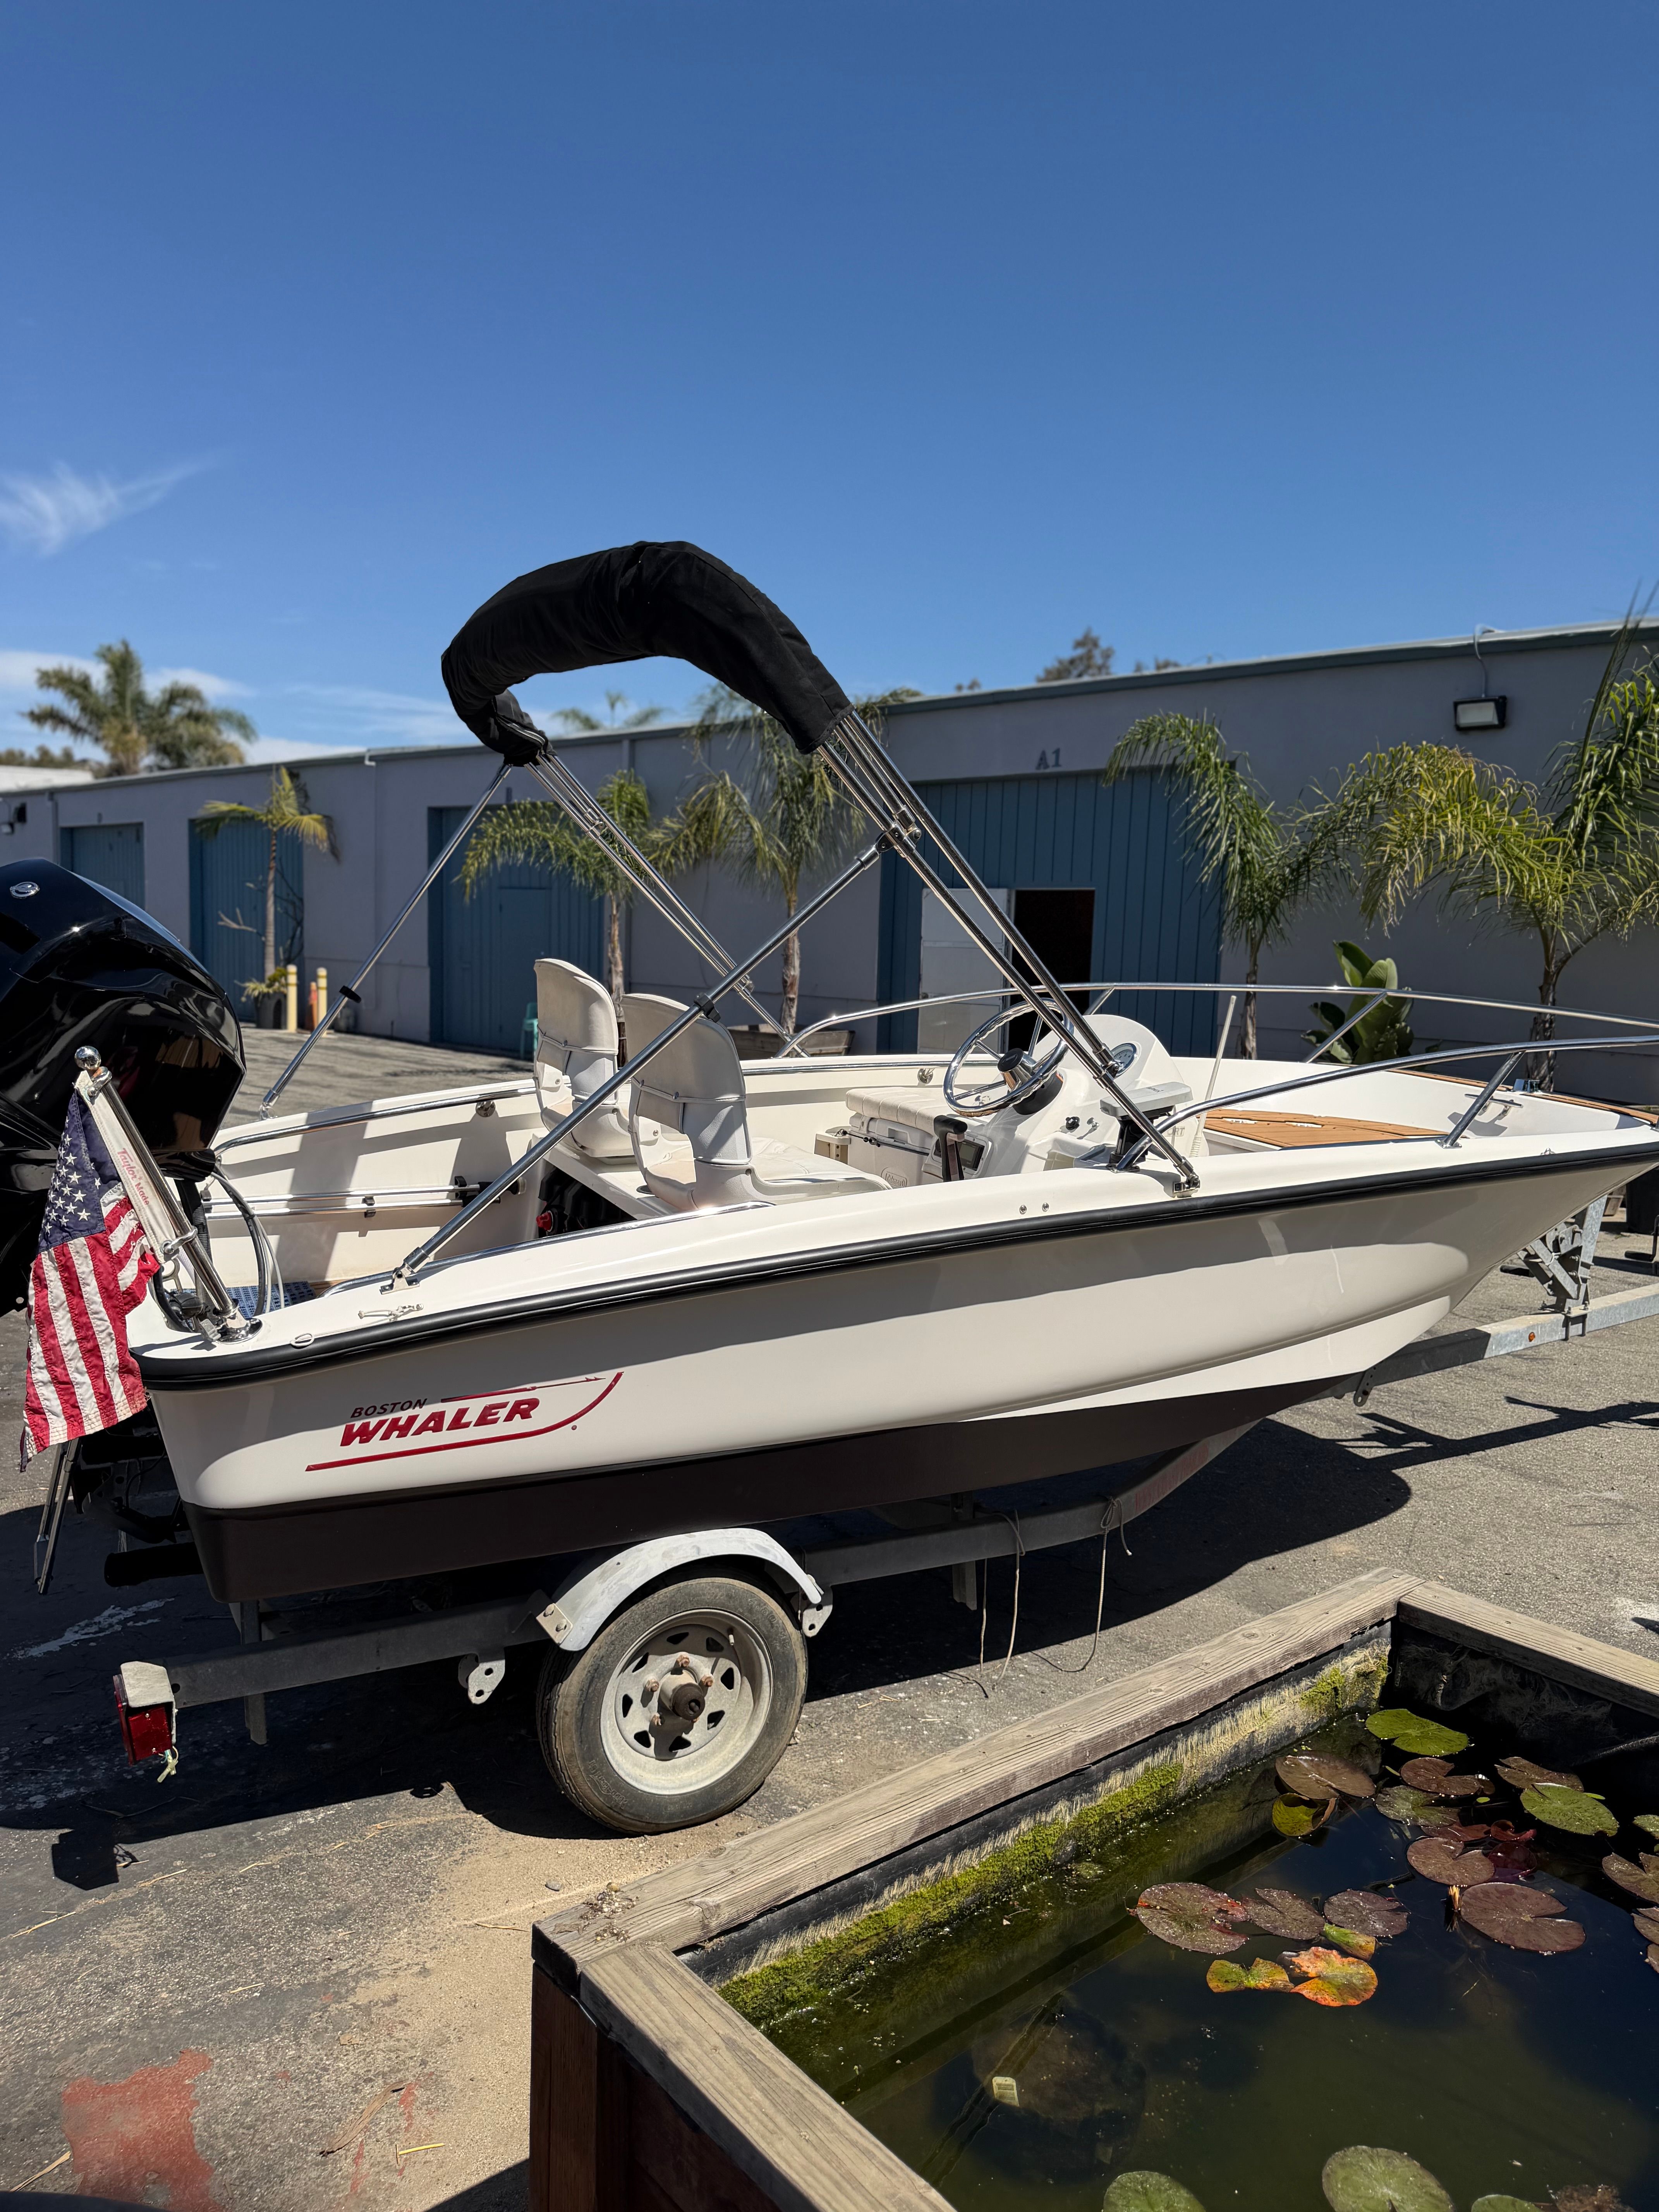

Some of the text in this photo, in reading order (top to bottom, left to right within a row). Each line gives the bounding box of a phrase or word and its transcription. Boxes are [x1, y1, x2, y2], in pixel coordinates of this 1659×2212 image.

[1036, 747, 1062, 770] A1
[1167, 1127, 1185, 1136] ORT
[117, 1148, 149, 1206] Taylor Made
[350, 1398, 428, 1418] BOSTON
[340, 1398, 540, 1446] WHALER
